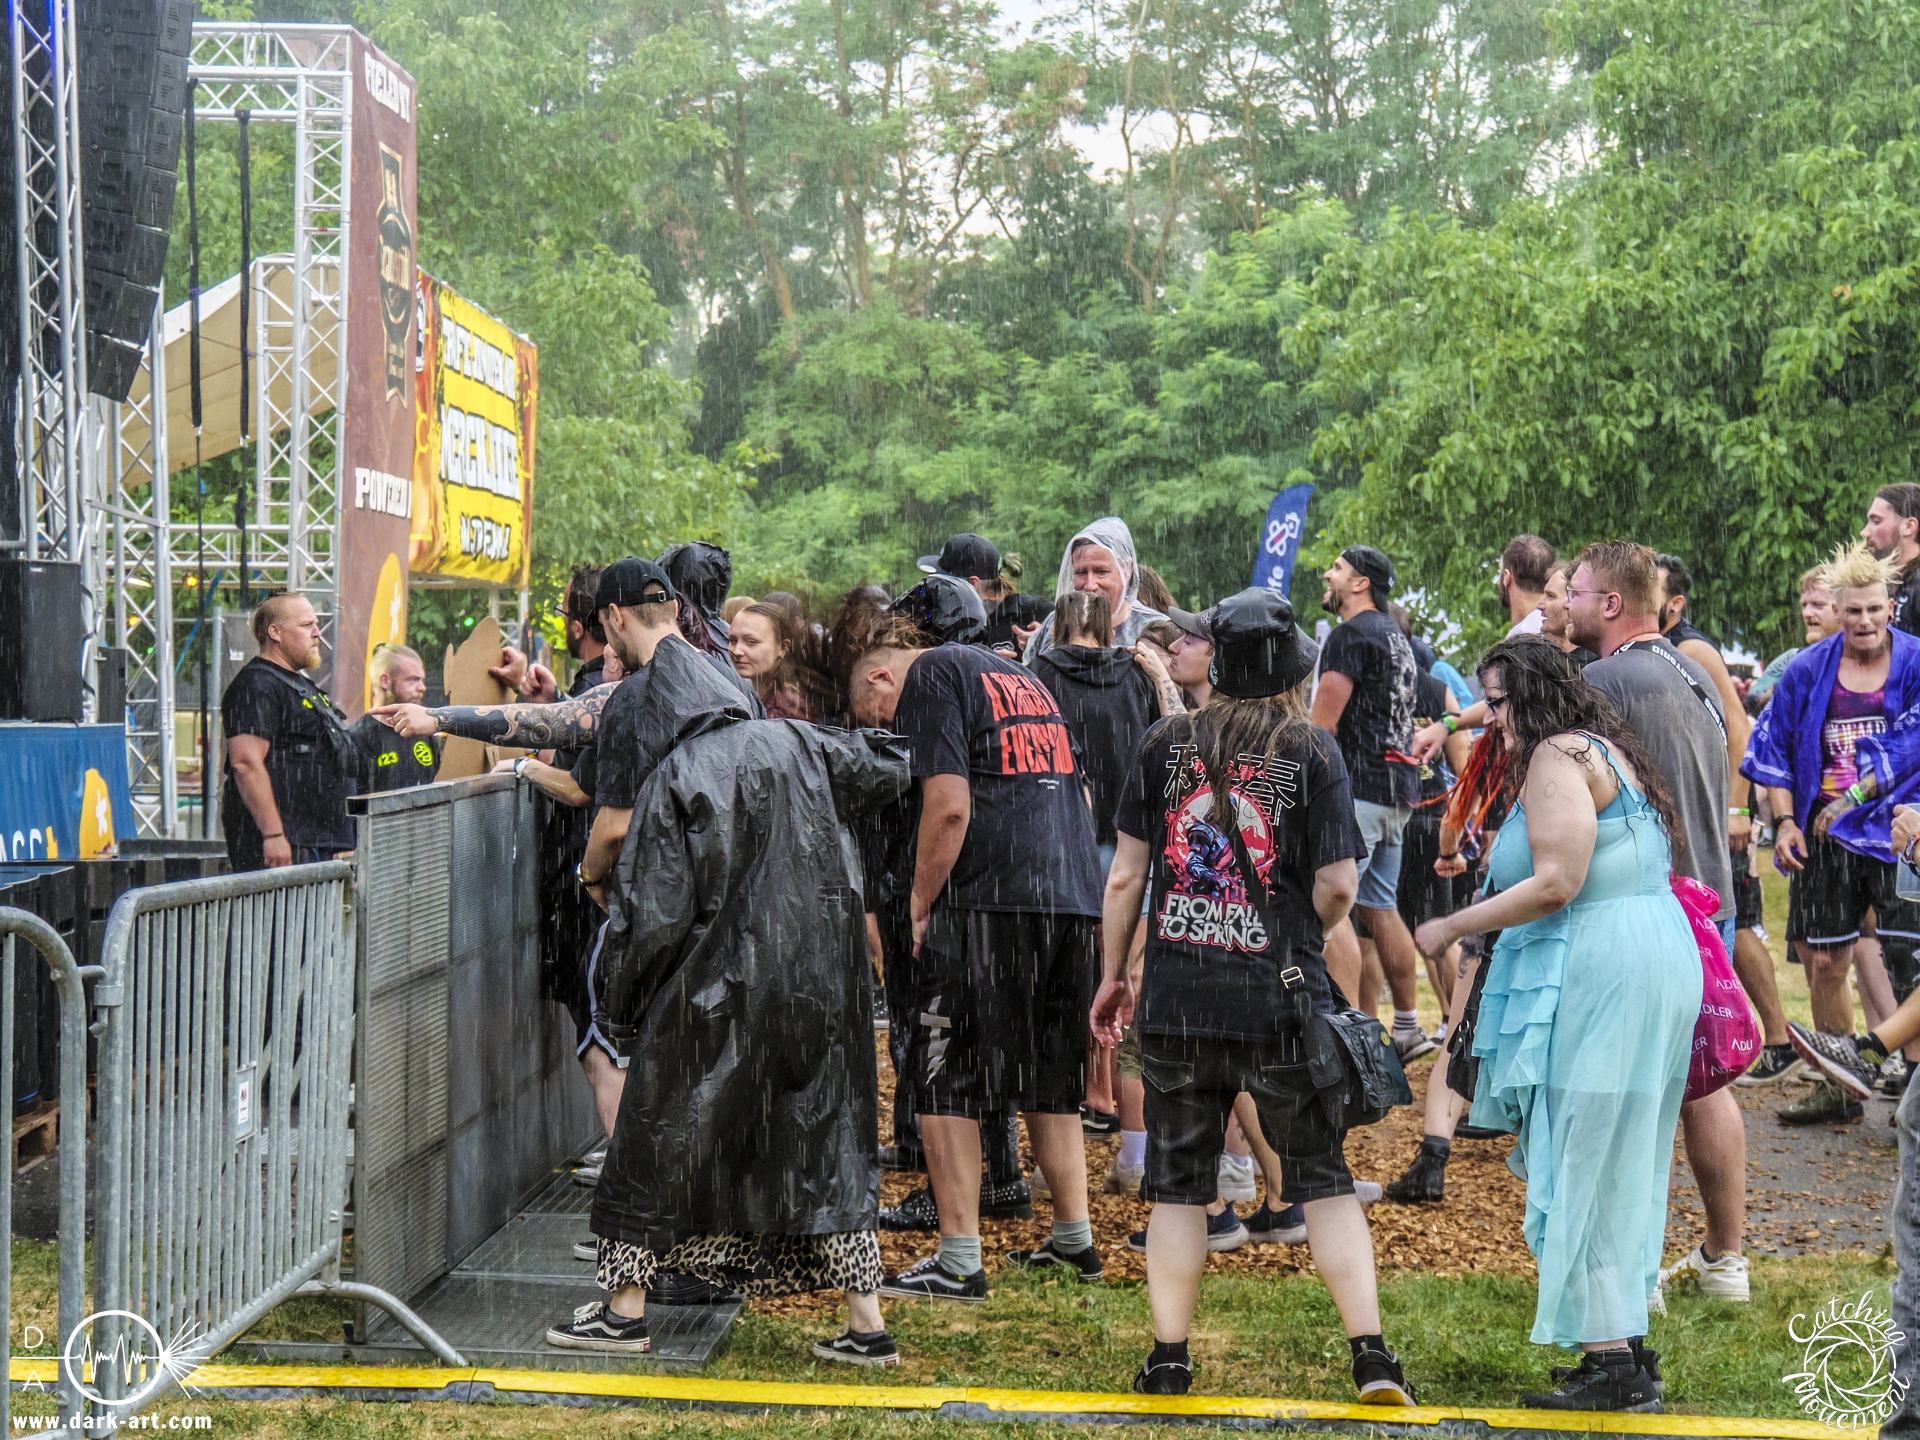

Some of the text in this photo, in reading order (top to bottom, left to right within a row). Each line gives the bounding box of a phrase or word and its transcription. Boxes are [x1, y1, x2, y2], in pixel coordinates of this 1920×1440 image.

[1166, 893, 1263, 928] FROM FALL
[1160, 914, 1268, 949] TO SPRING
